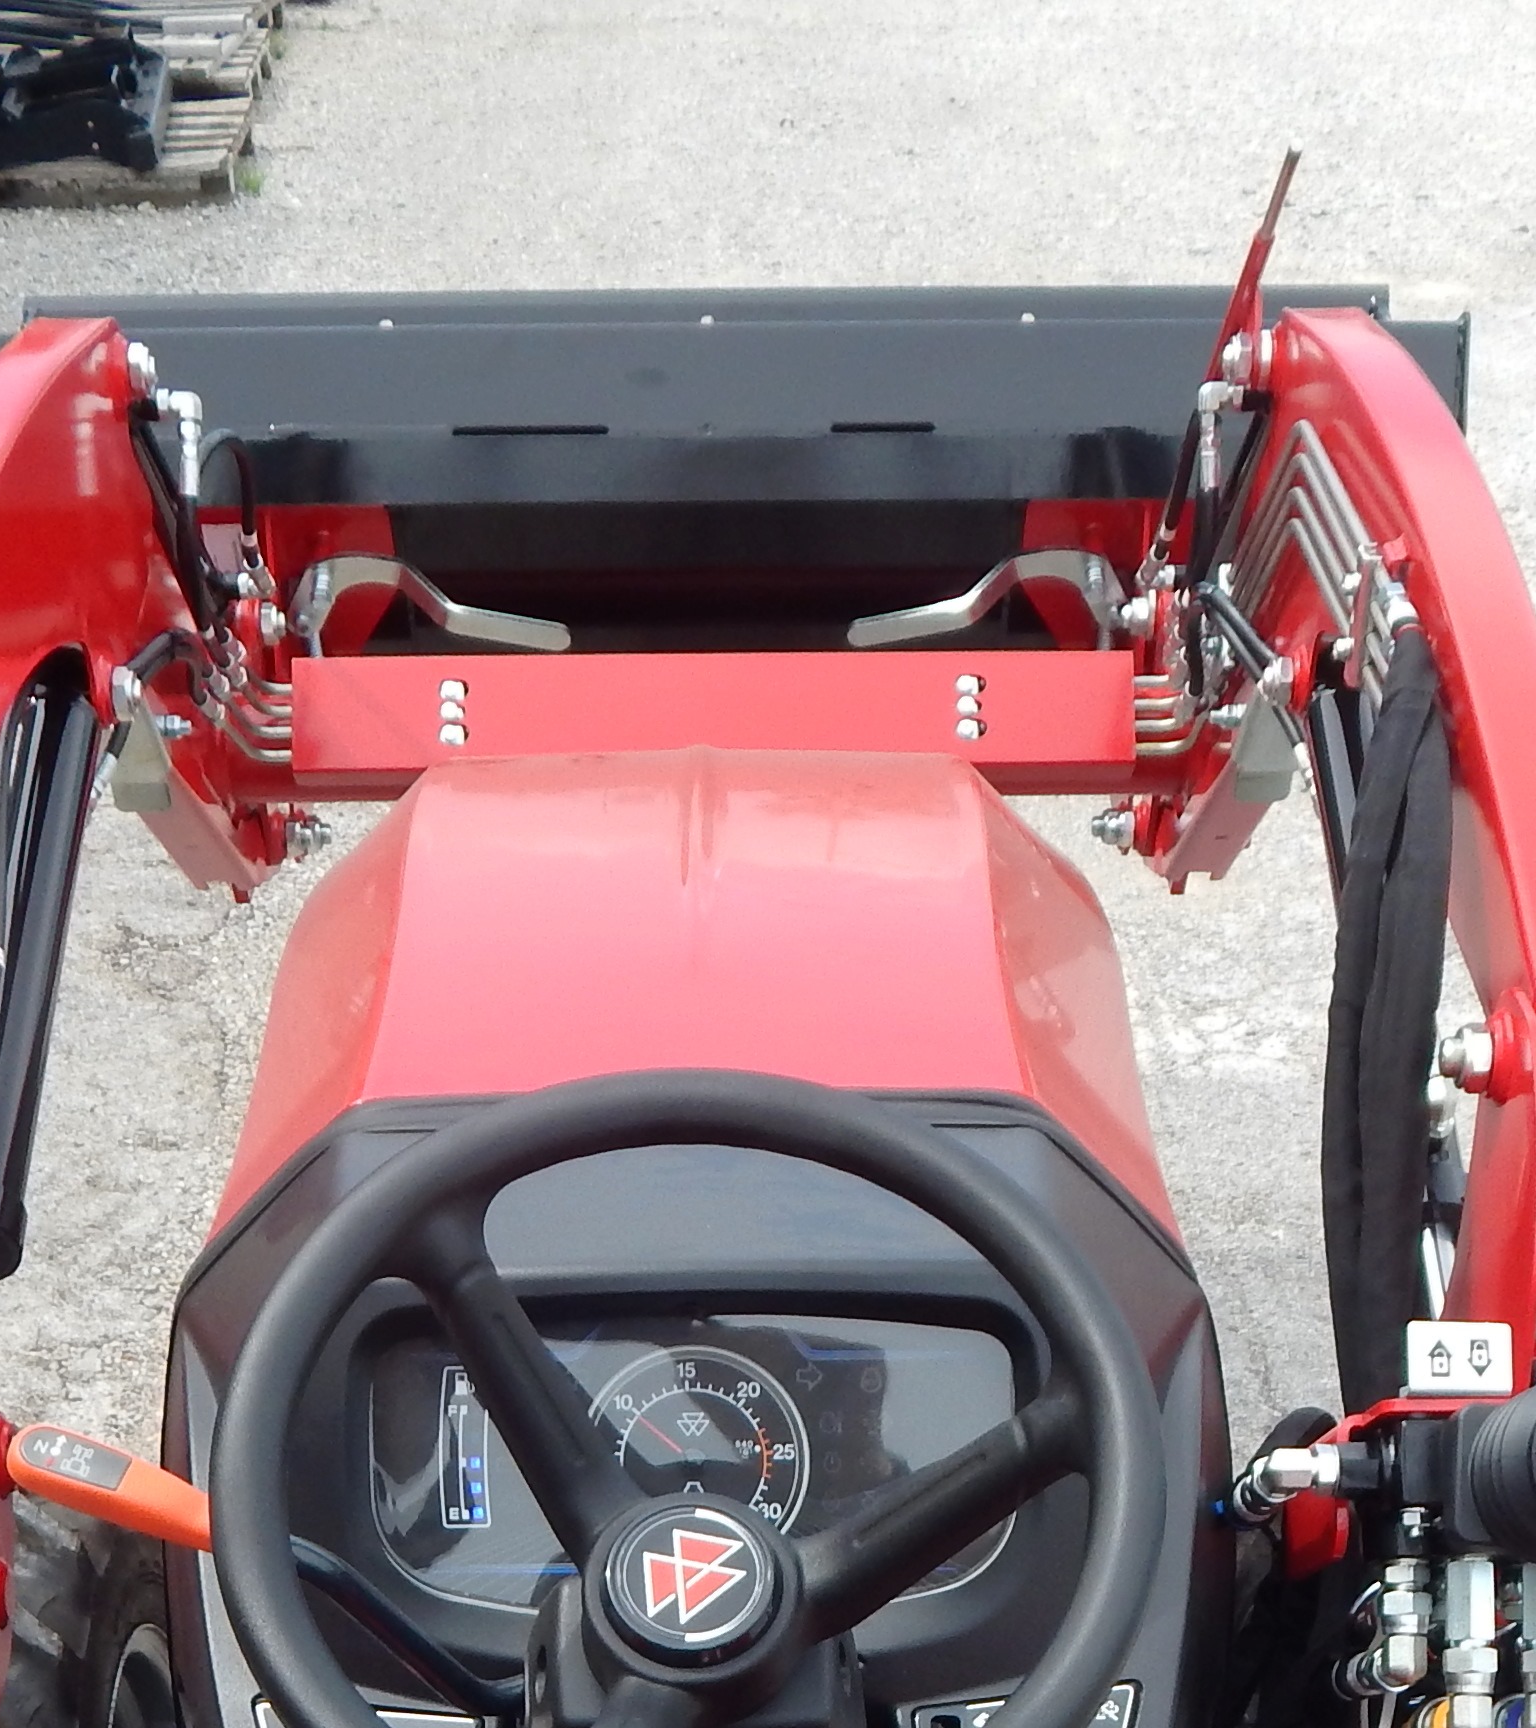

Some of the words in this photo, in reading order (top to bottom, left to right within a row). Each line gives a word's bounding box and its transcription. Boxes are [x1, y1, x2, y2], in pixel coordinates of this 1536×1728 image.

[677, 1362, 696, 1378] 15
[736, 1382, 761, 1398] 20
[613, 1394, 633, 1410] 10
[448, 1405, 457, 1417] F
[33, 1439, 49, 1454] N
[773, 1443, 795, 1460] 25
[449, 1507, 459, 1520] E
[759, 1502, 782, 1519] 30
